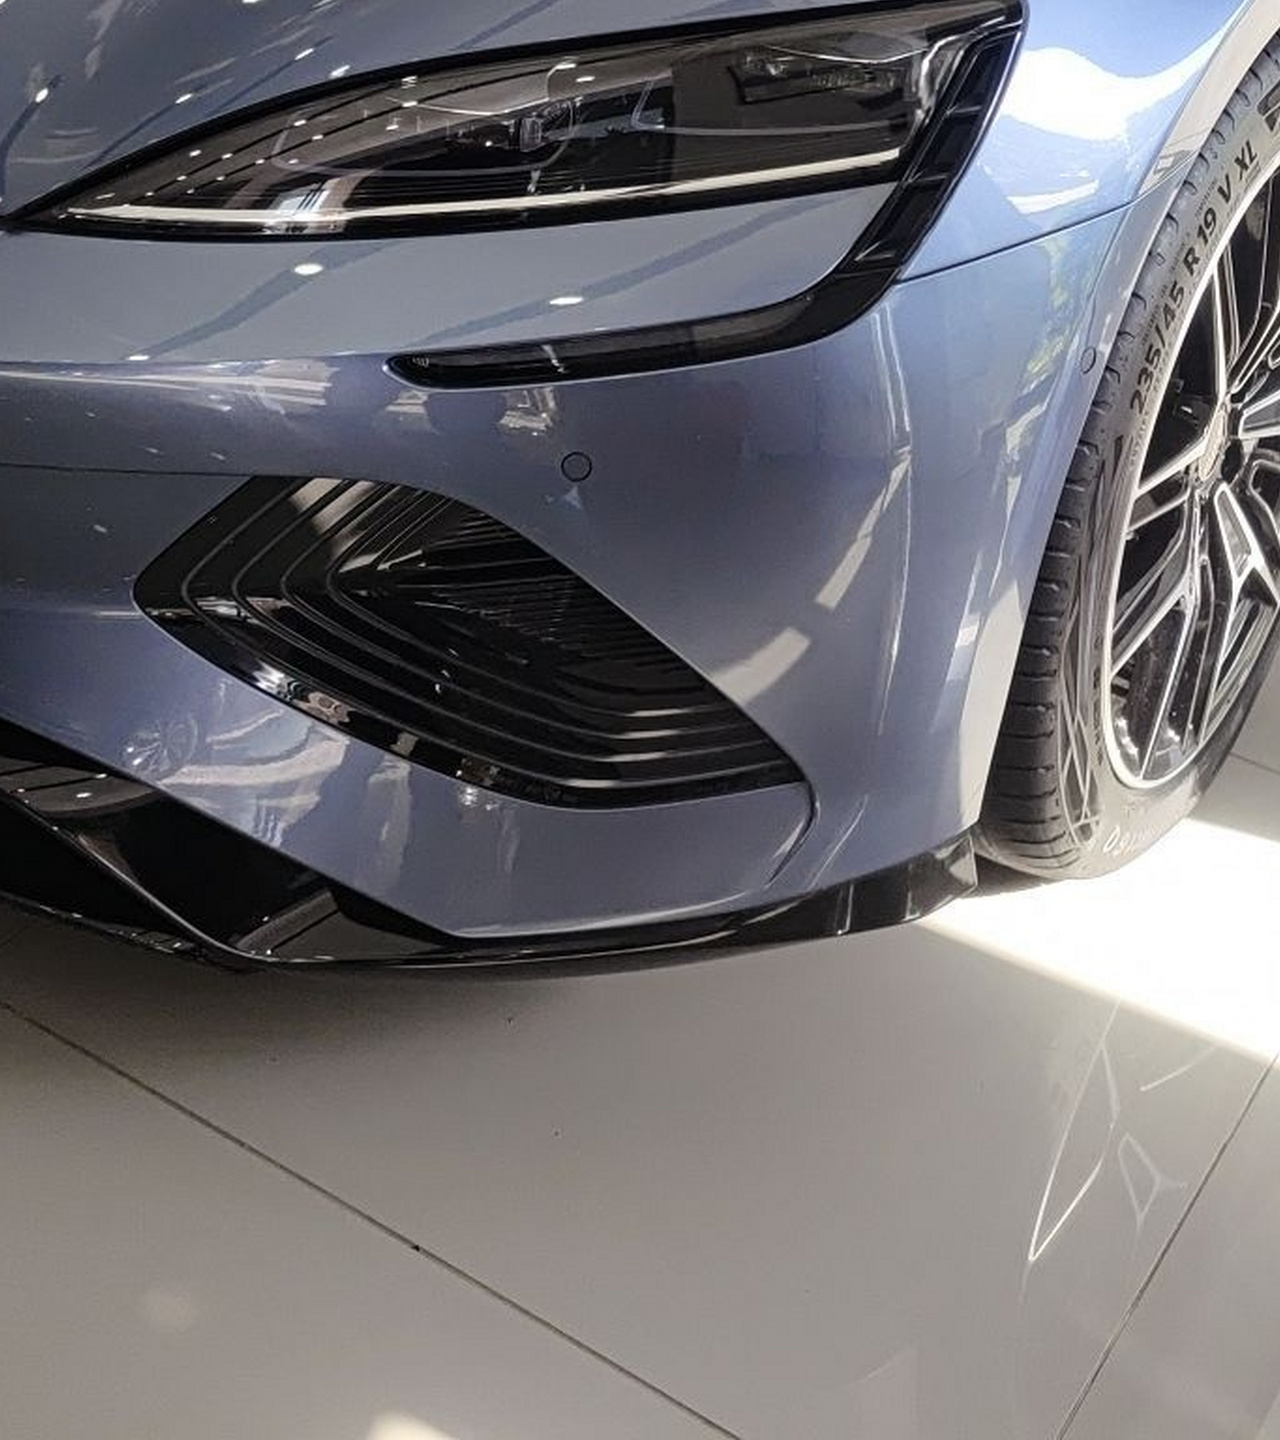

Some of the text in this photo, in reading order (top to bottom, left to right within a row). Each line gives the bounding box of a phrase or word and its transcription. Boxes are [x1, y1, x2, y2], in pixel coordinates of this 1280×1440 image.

[1130, 280, 1185, 415] 235/45
[1183, 246, 1201, 276] R
[1197, 207, 1217, 246] 19
[1217, 173, 1232, 204] V
[1234, 139, 1258, 181] XL
